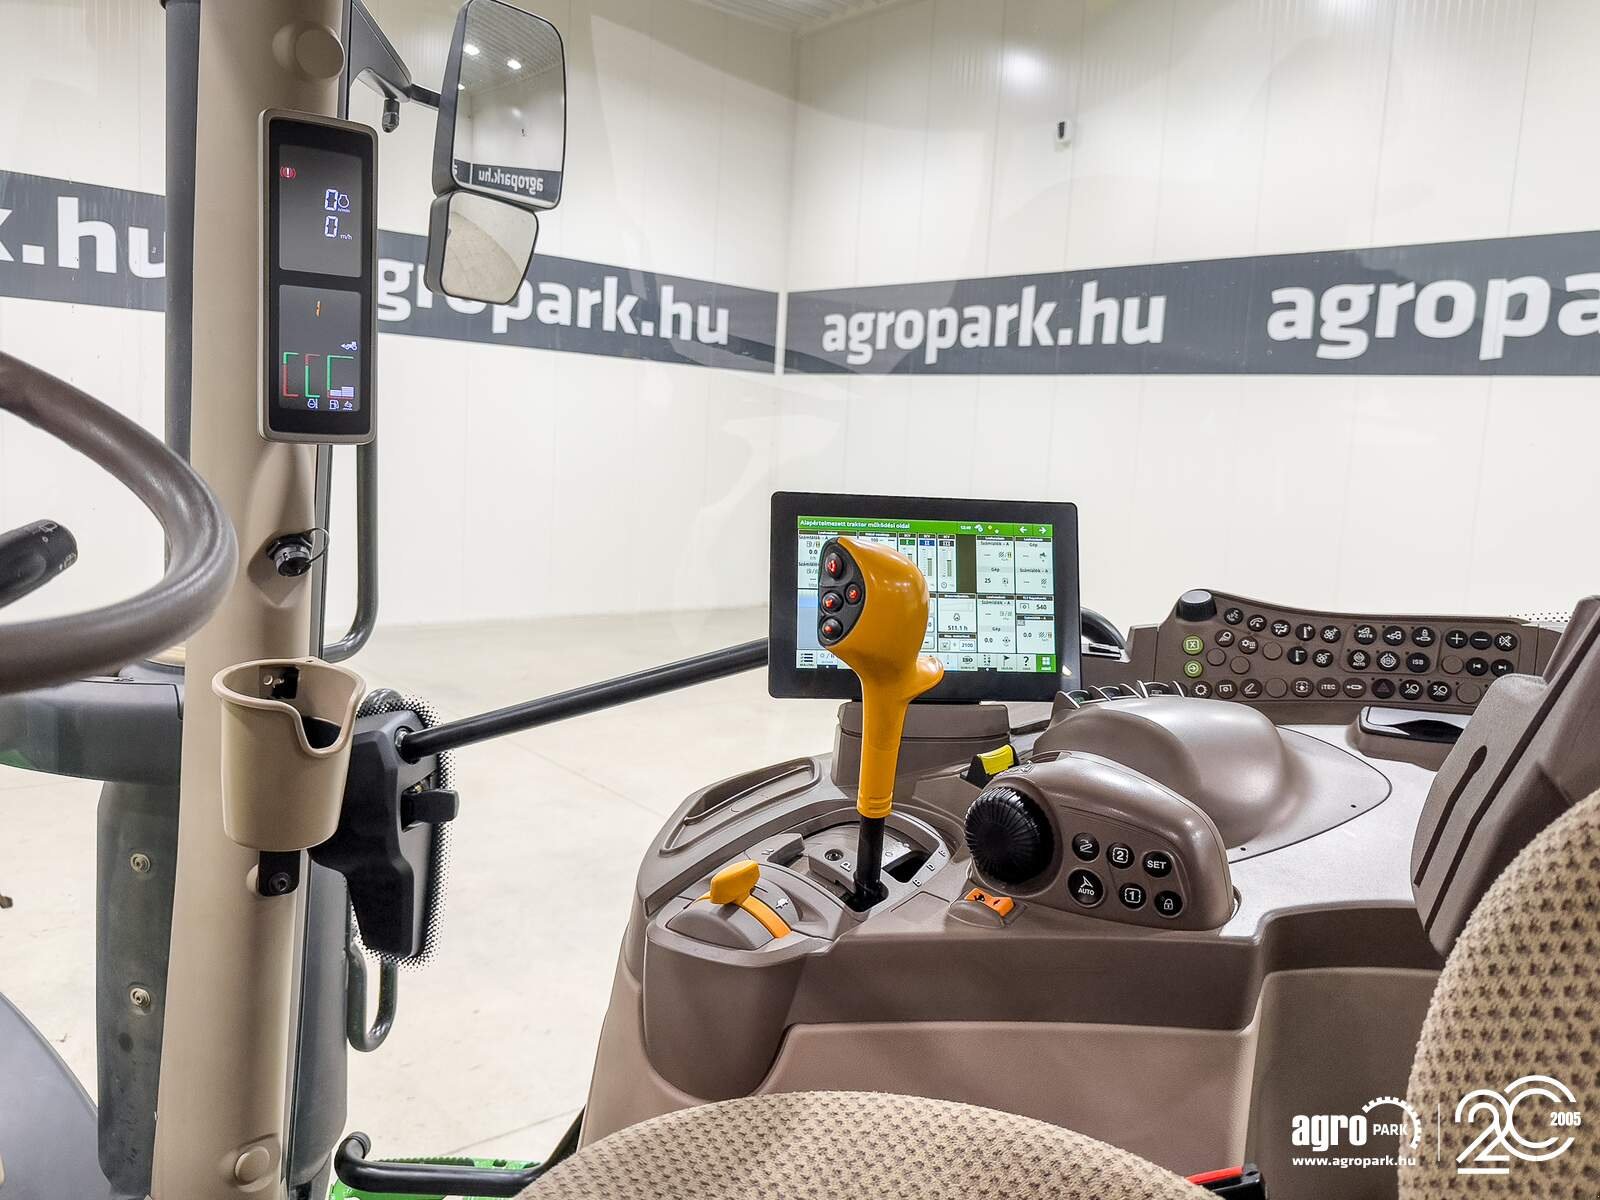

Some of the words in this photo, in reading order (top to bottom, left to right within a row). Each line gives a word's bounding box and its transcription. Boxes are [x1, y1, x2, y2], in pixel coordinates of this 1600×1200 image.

[325, 189, 339, 211] 0
[325, 215, 339, 238] 0
[822, 281, 1167, 365] agropark.hu
[1266, 272, 1600, 361] agropa
[1116, 850, 1124, 861] 2
[1147, 860, 1167, 869] SET
[1078, 887, 1095, 896] AUTO
[1129, 891, 1135, 901] 1
